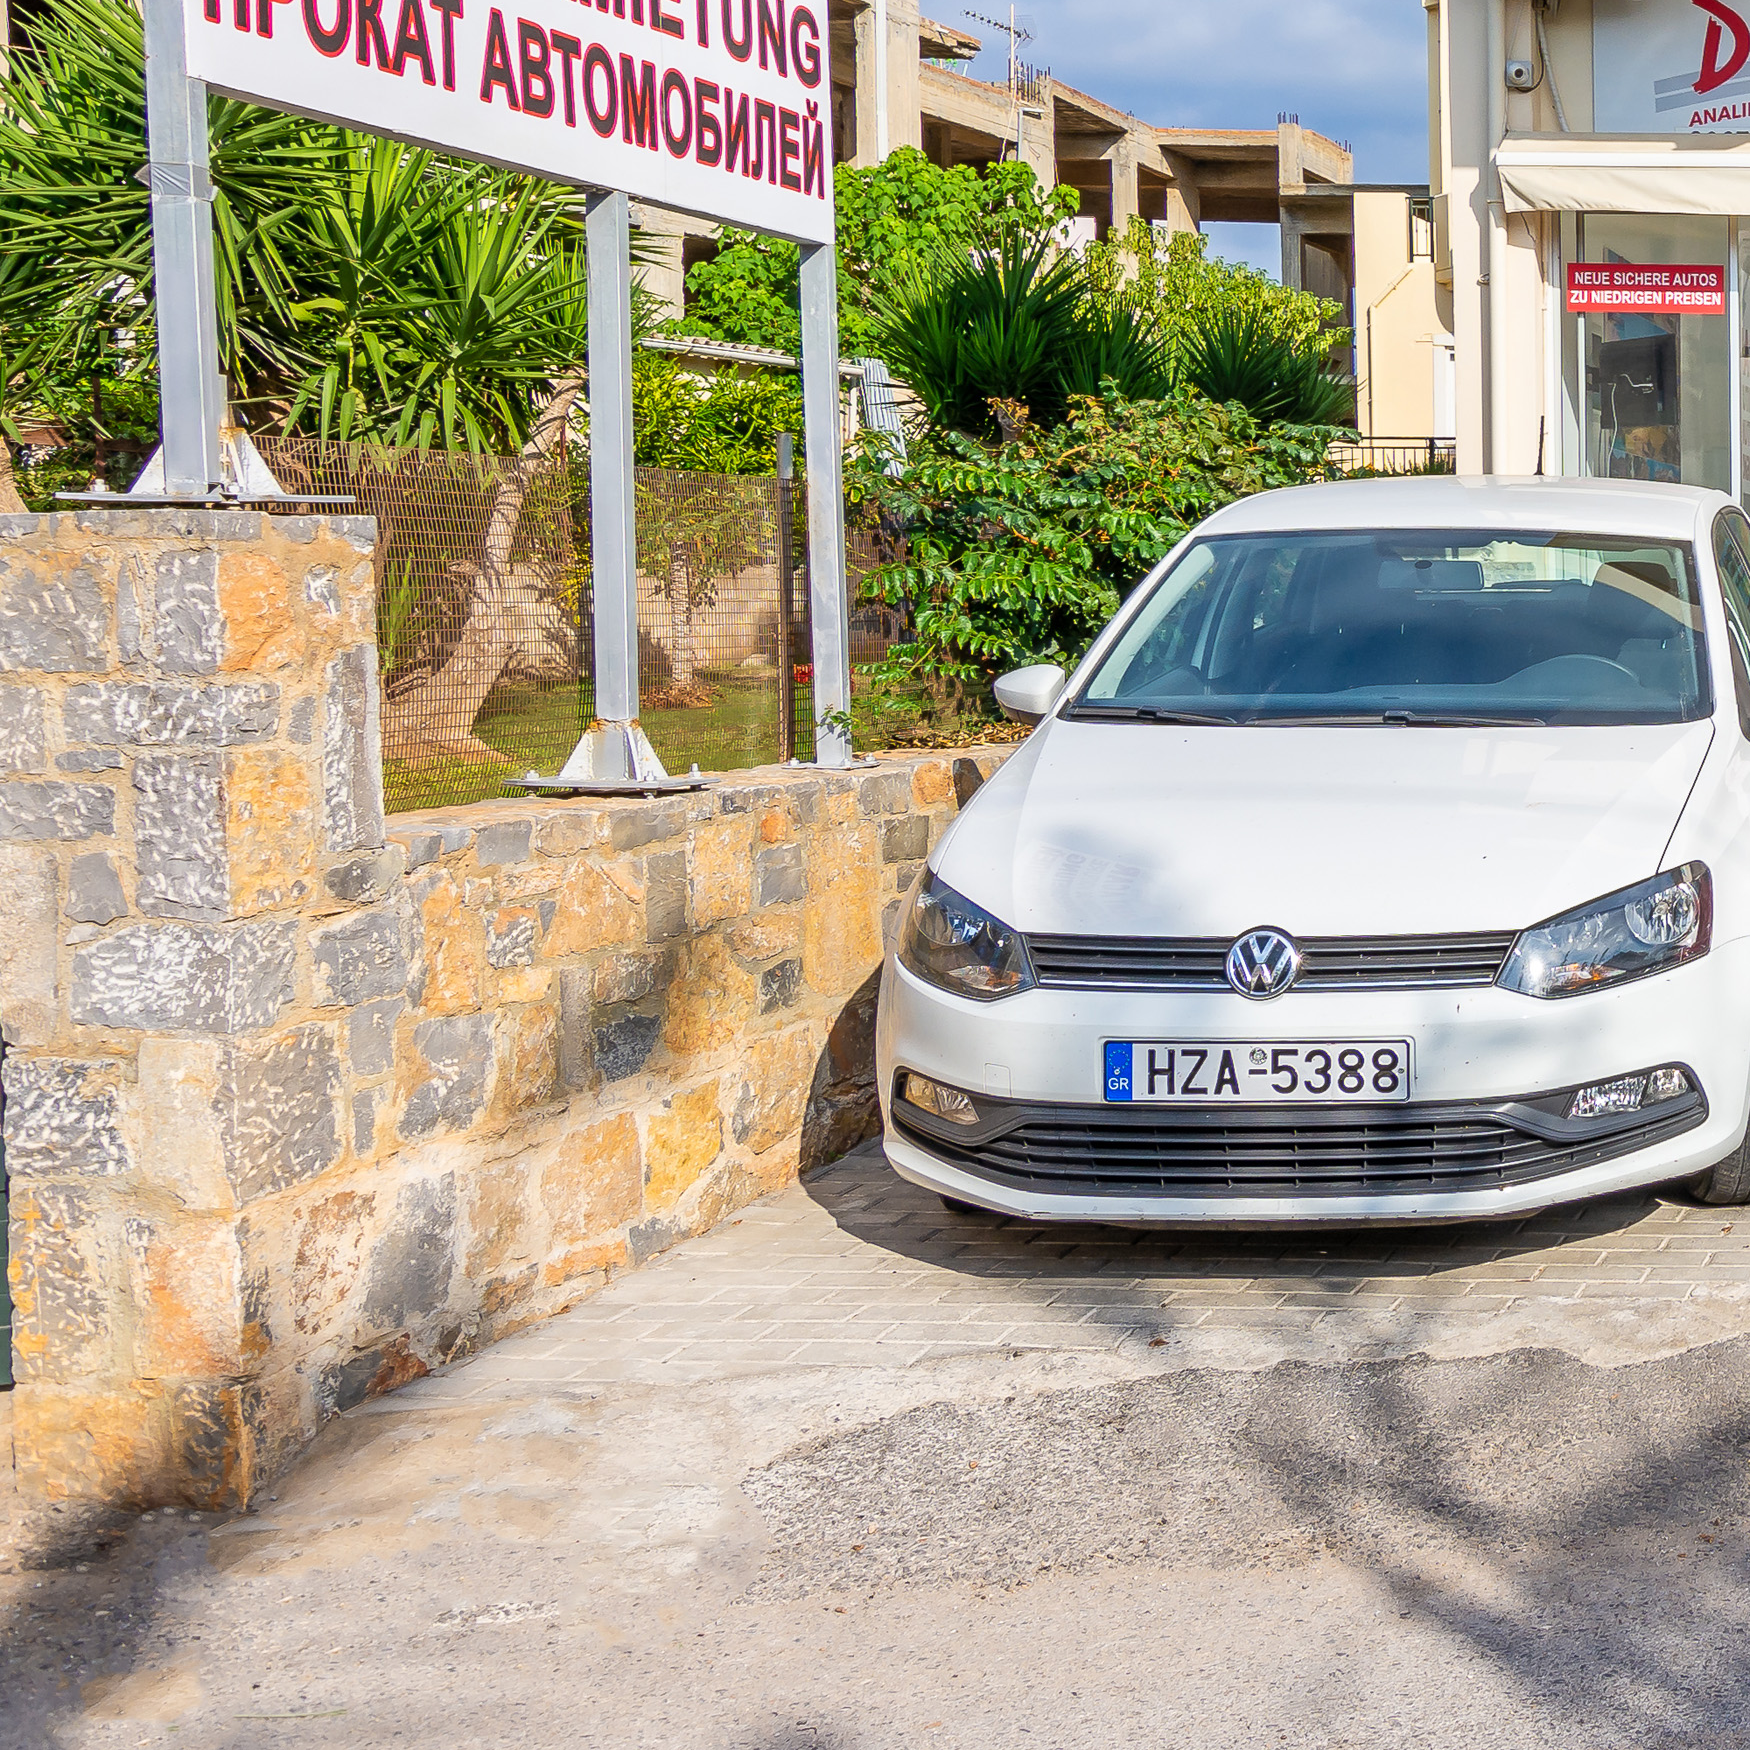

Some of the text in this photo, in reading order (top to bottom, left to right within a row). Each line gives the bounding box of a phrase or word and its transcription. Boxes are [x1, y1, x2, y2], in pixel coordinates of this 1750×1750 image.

[480, 6, 825, 200] АВТОМОБИЛЕЙ
[1574, 272, 1718, 286] NEUE SICHERE AUTOS
[1570, 290, 1722, 306] ZU NIEDRIGEN PREISEN
[1108, 1048, 1400, 1095] GR HZA-5388
